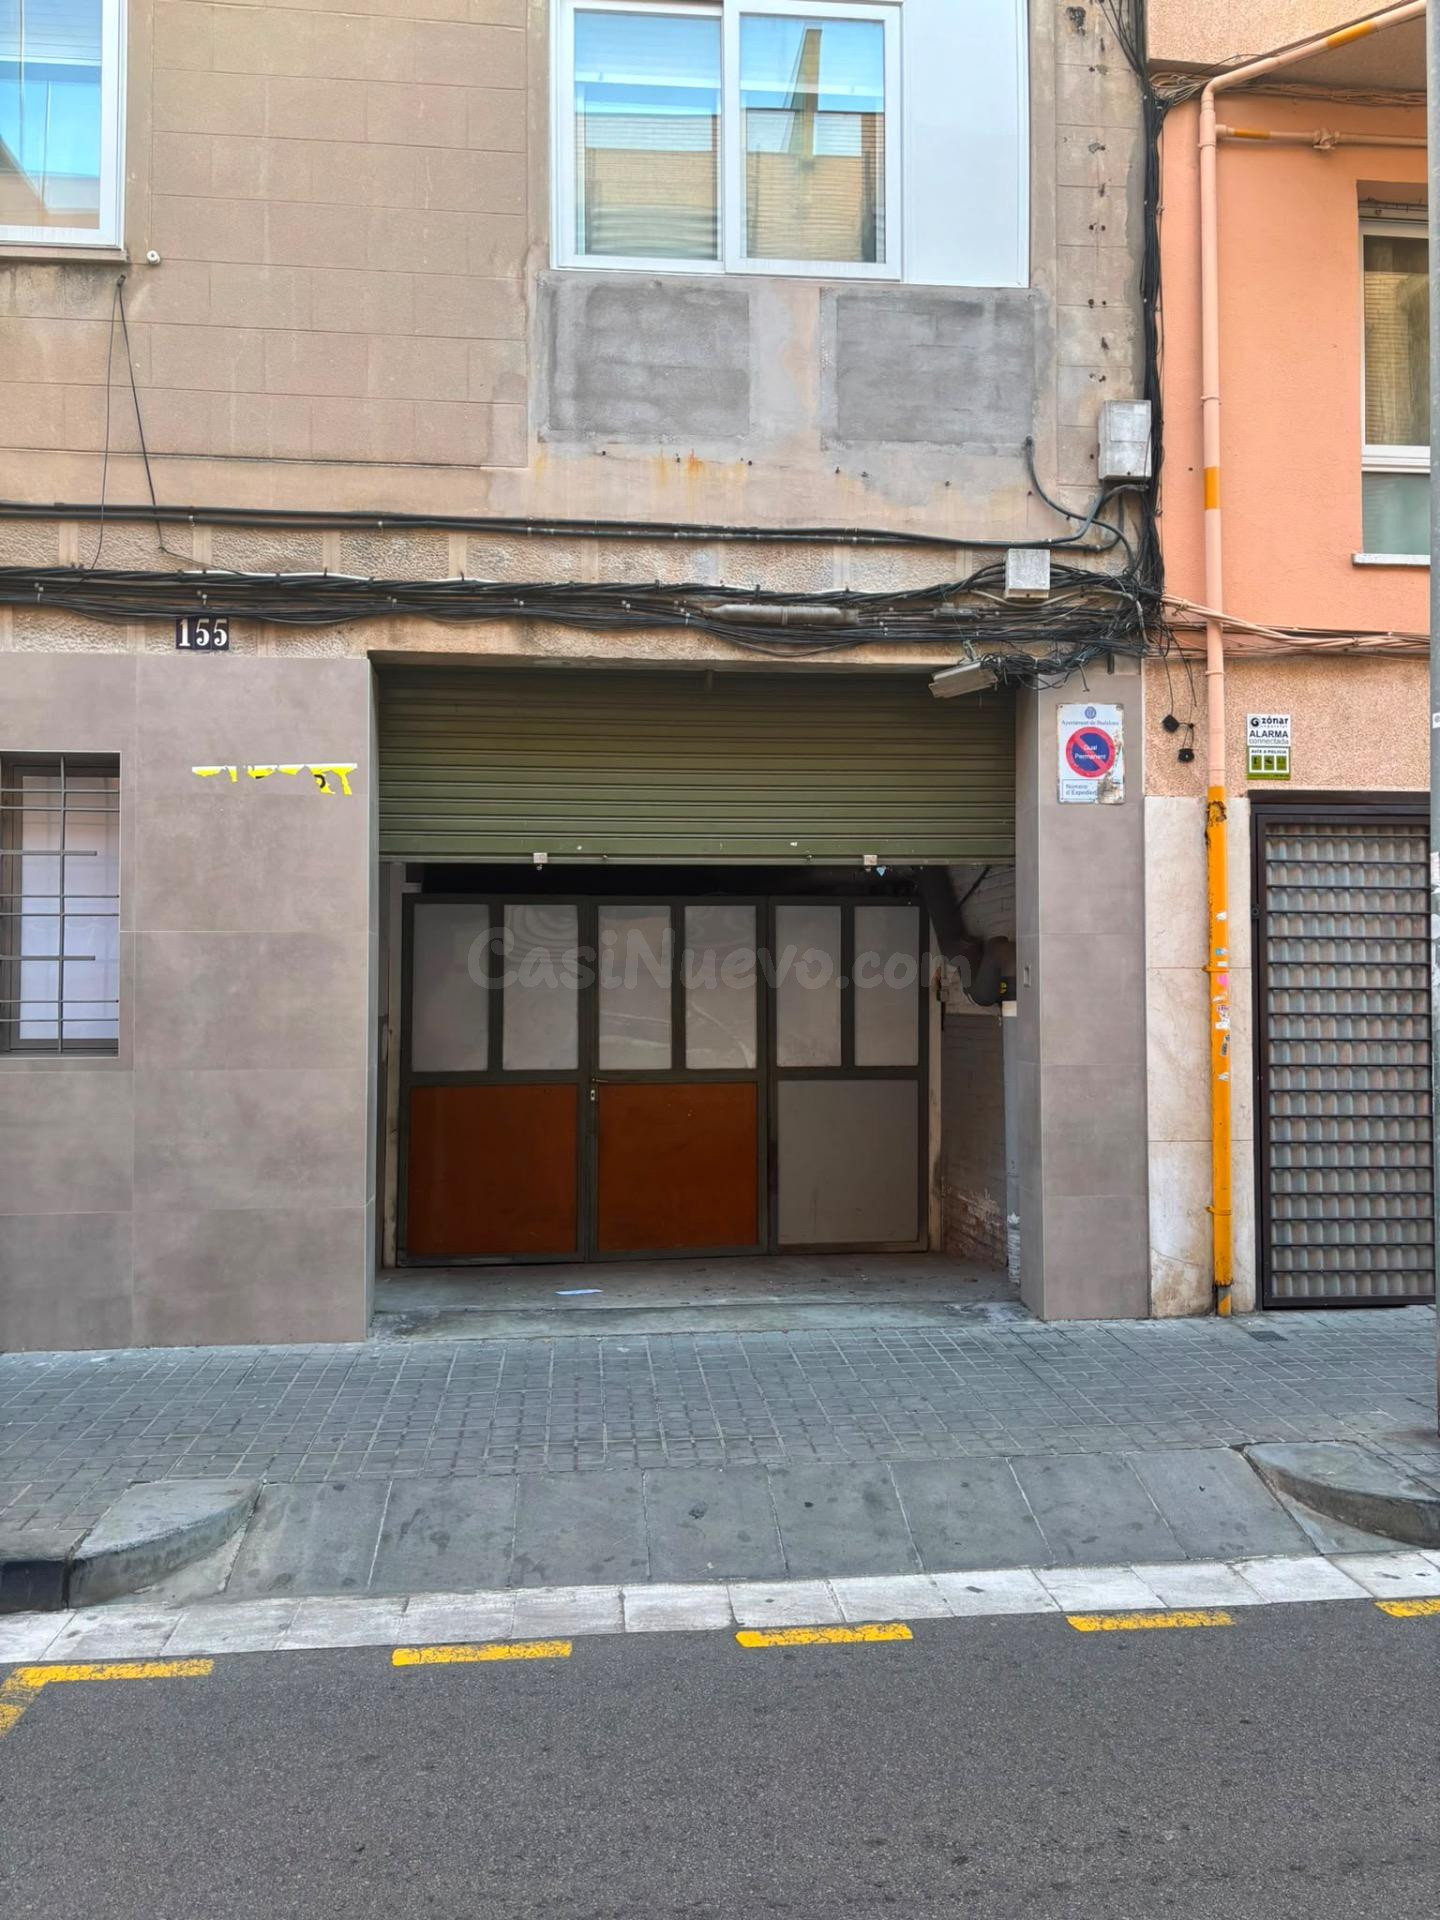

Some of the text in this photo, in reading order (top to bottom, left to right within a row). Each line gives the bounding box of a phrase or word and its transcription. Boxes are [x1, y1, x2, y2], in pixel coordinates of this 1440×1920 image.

[178, 618, 227, 647] 155
[1261, 715, 1288, 724] zónar
[1249, 730, 1288, 738] ALARMA
